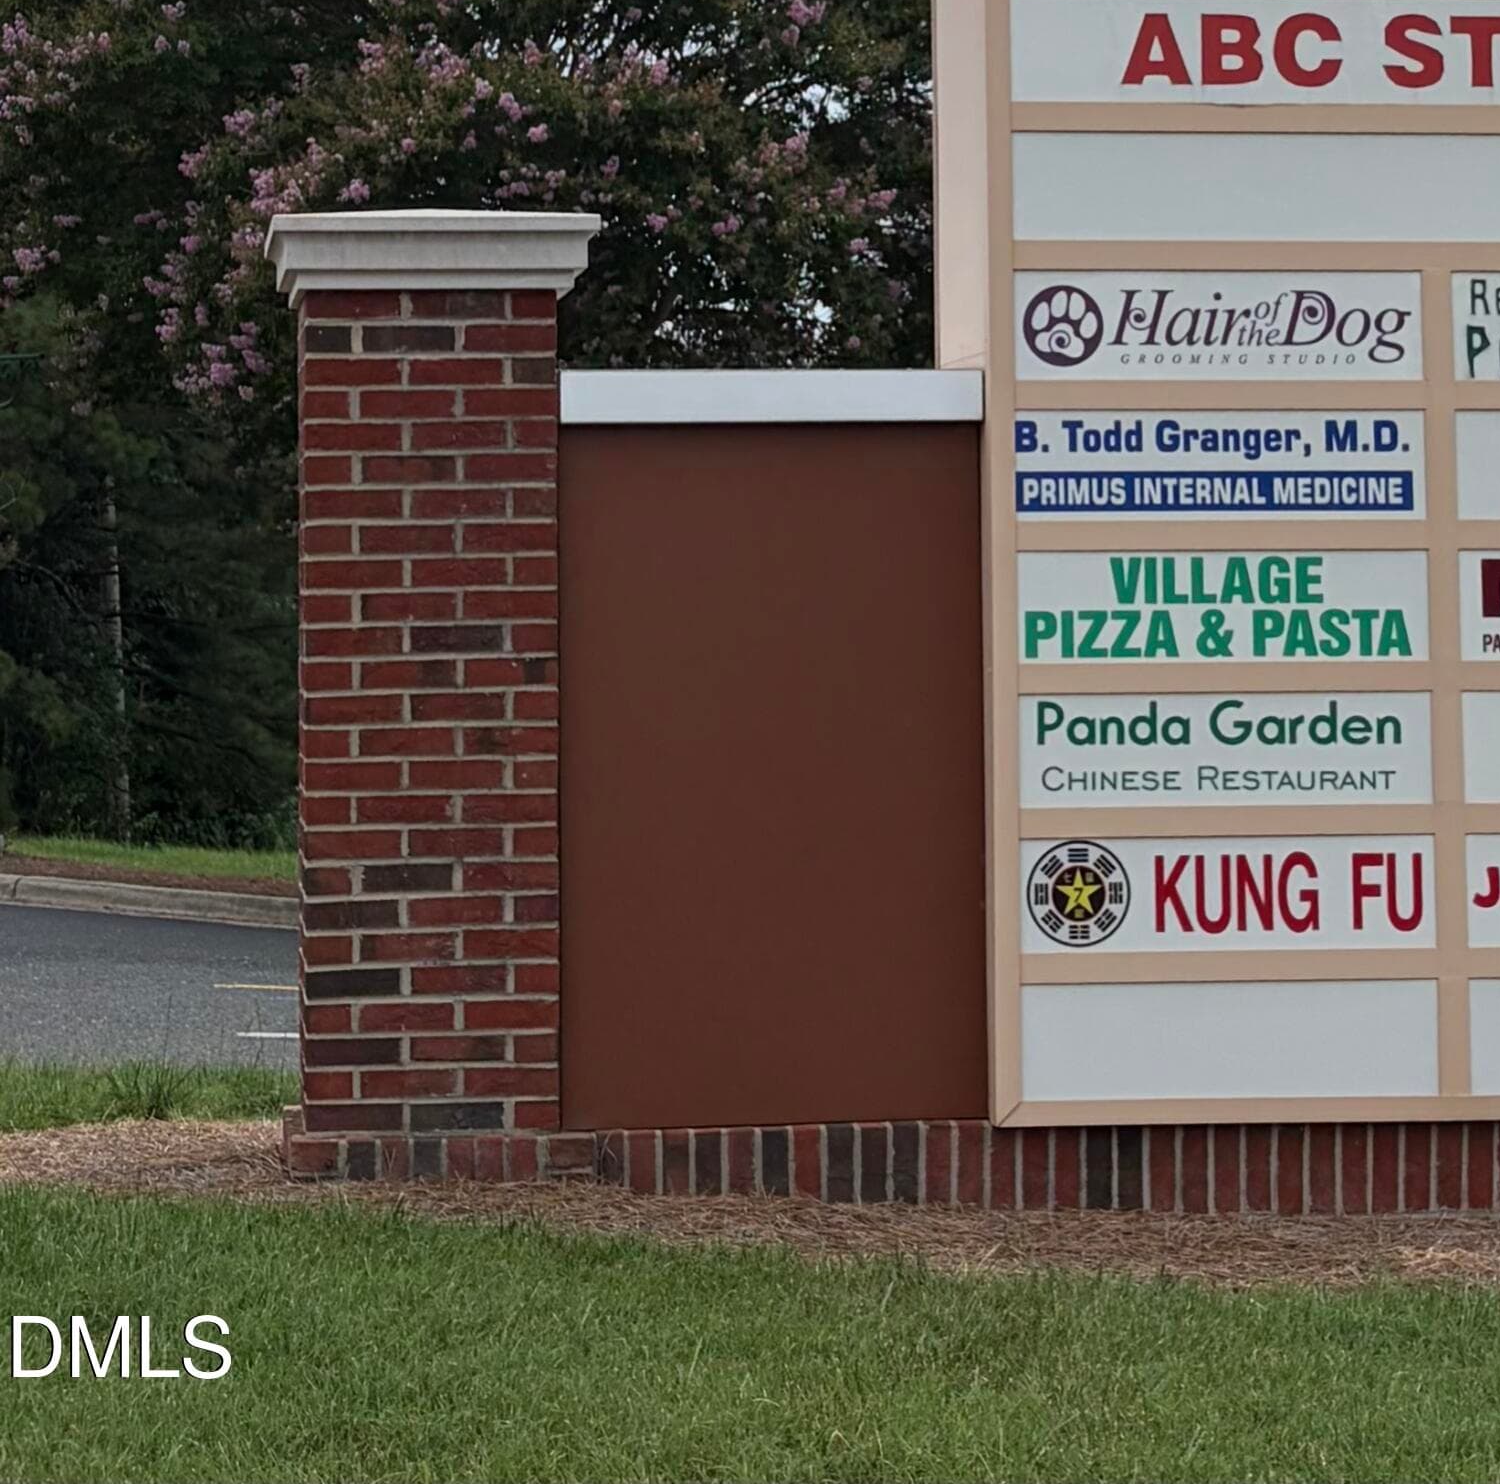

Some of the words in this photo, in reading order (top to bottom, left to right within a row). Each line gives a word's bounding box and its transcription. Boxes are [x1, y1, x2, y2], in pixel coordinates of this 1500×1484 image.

[1120, 12, 1344, 88] ABC
[1107, 289, 1251, 347] Hair
[1255, 292, 1288, 322] of
[1283, 289, 1412, 364] Dog
[1120, 352, 1249, 366] GROOMING
[1267, 352, 1358, 365] STUDIO
[1238, 324, 1281, 348] the
[1014, 420, 1050, 454] B.
[1061, 419, 1144, 454] Todd
[1154, 419, 1312, 461] Granger,
[1324, 419, 1411, 453] M.D.
[1022, 478, 1127, 507] PRIMUS
[1133, 477, 1266, 506] INTERNAL
[1272, 476, 1404, 505] MEDICINE
[1109, 556, 1325, 605] VILLAGE
[1024, 610, 1180, 659] PIZZA
[1195, 608, 1235, 658] &
[1251, 608, 1413, 658] PASTA
[1036, 700, 1191, 747] Panda
[1208, 699, 1403, 746] Garden
[1041, 765, 1183, 792] CHINESE
[1197, 765, 1397, 792] RESTAURANT
[1154, 850, 1321, 935] KUNG
[1351, 852, 1424, 932] FU
